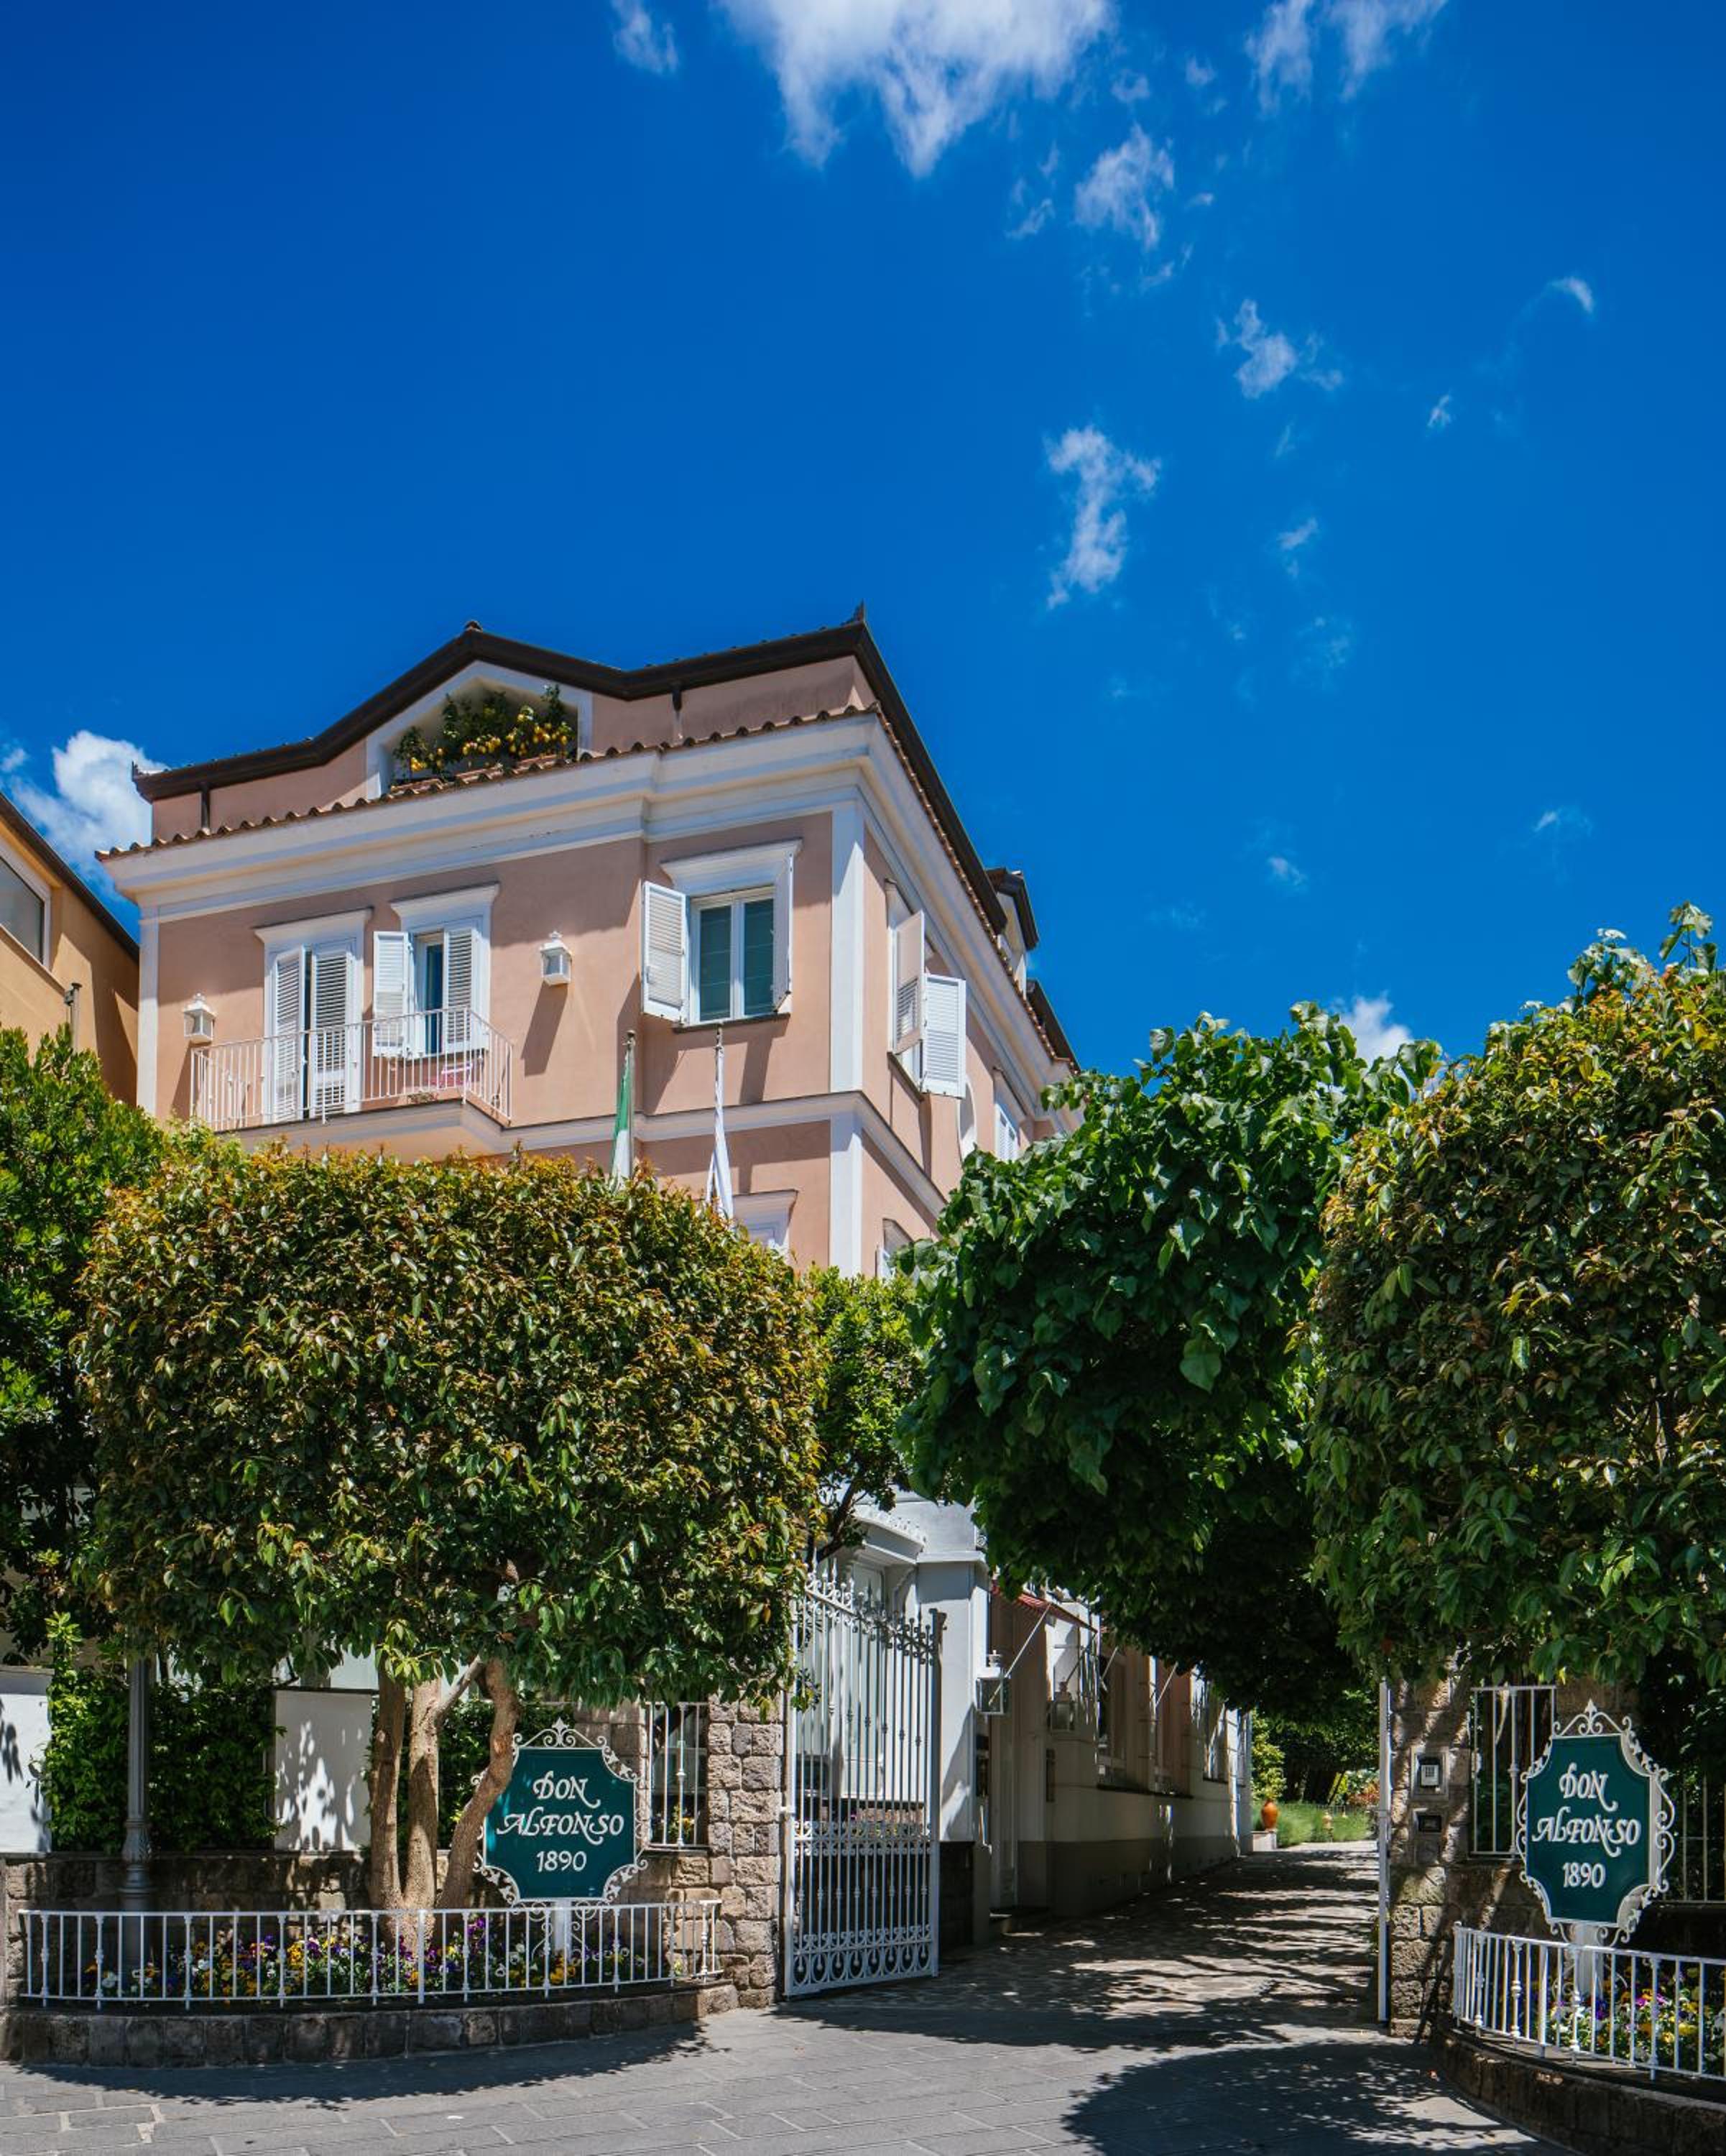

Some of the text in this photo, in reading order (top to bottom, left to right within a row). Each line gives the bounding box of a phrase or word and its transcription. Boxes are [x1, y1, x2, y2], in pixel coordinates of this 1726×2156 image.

[532, 1770, 601, 1808] DON
[1559, 1762, 1619, 1812] DON
[496, 1806, 624, 1845] ALFONSO
[1531, 1806, 1642, 1858] ALFONSO
[536, 1851, 587, 1873] 1890
[1561, 1862, 1606, 1889] 1890
